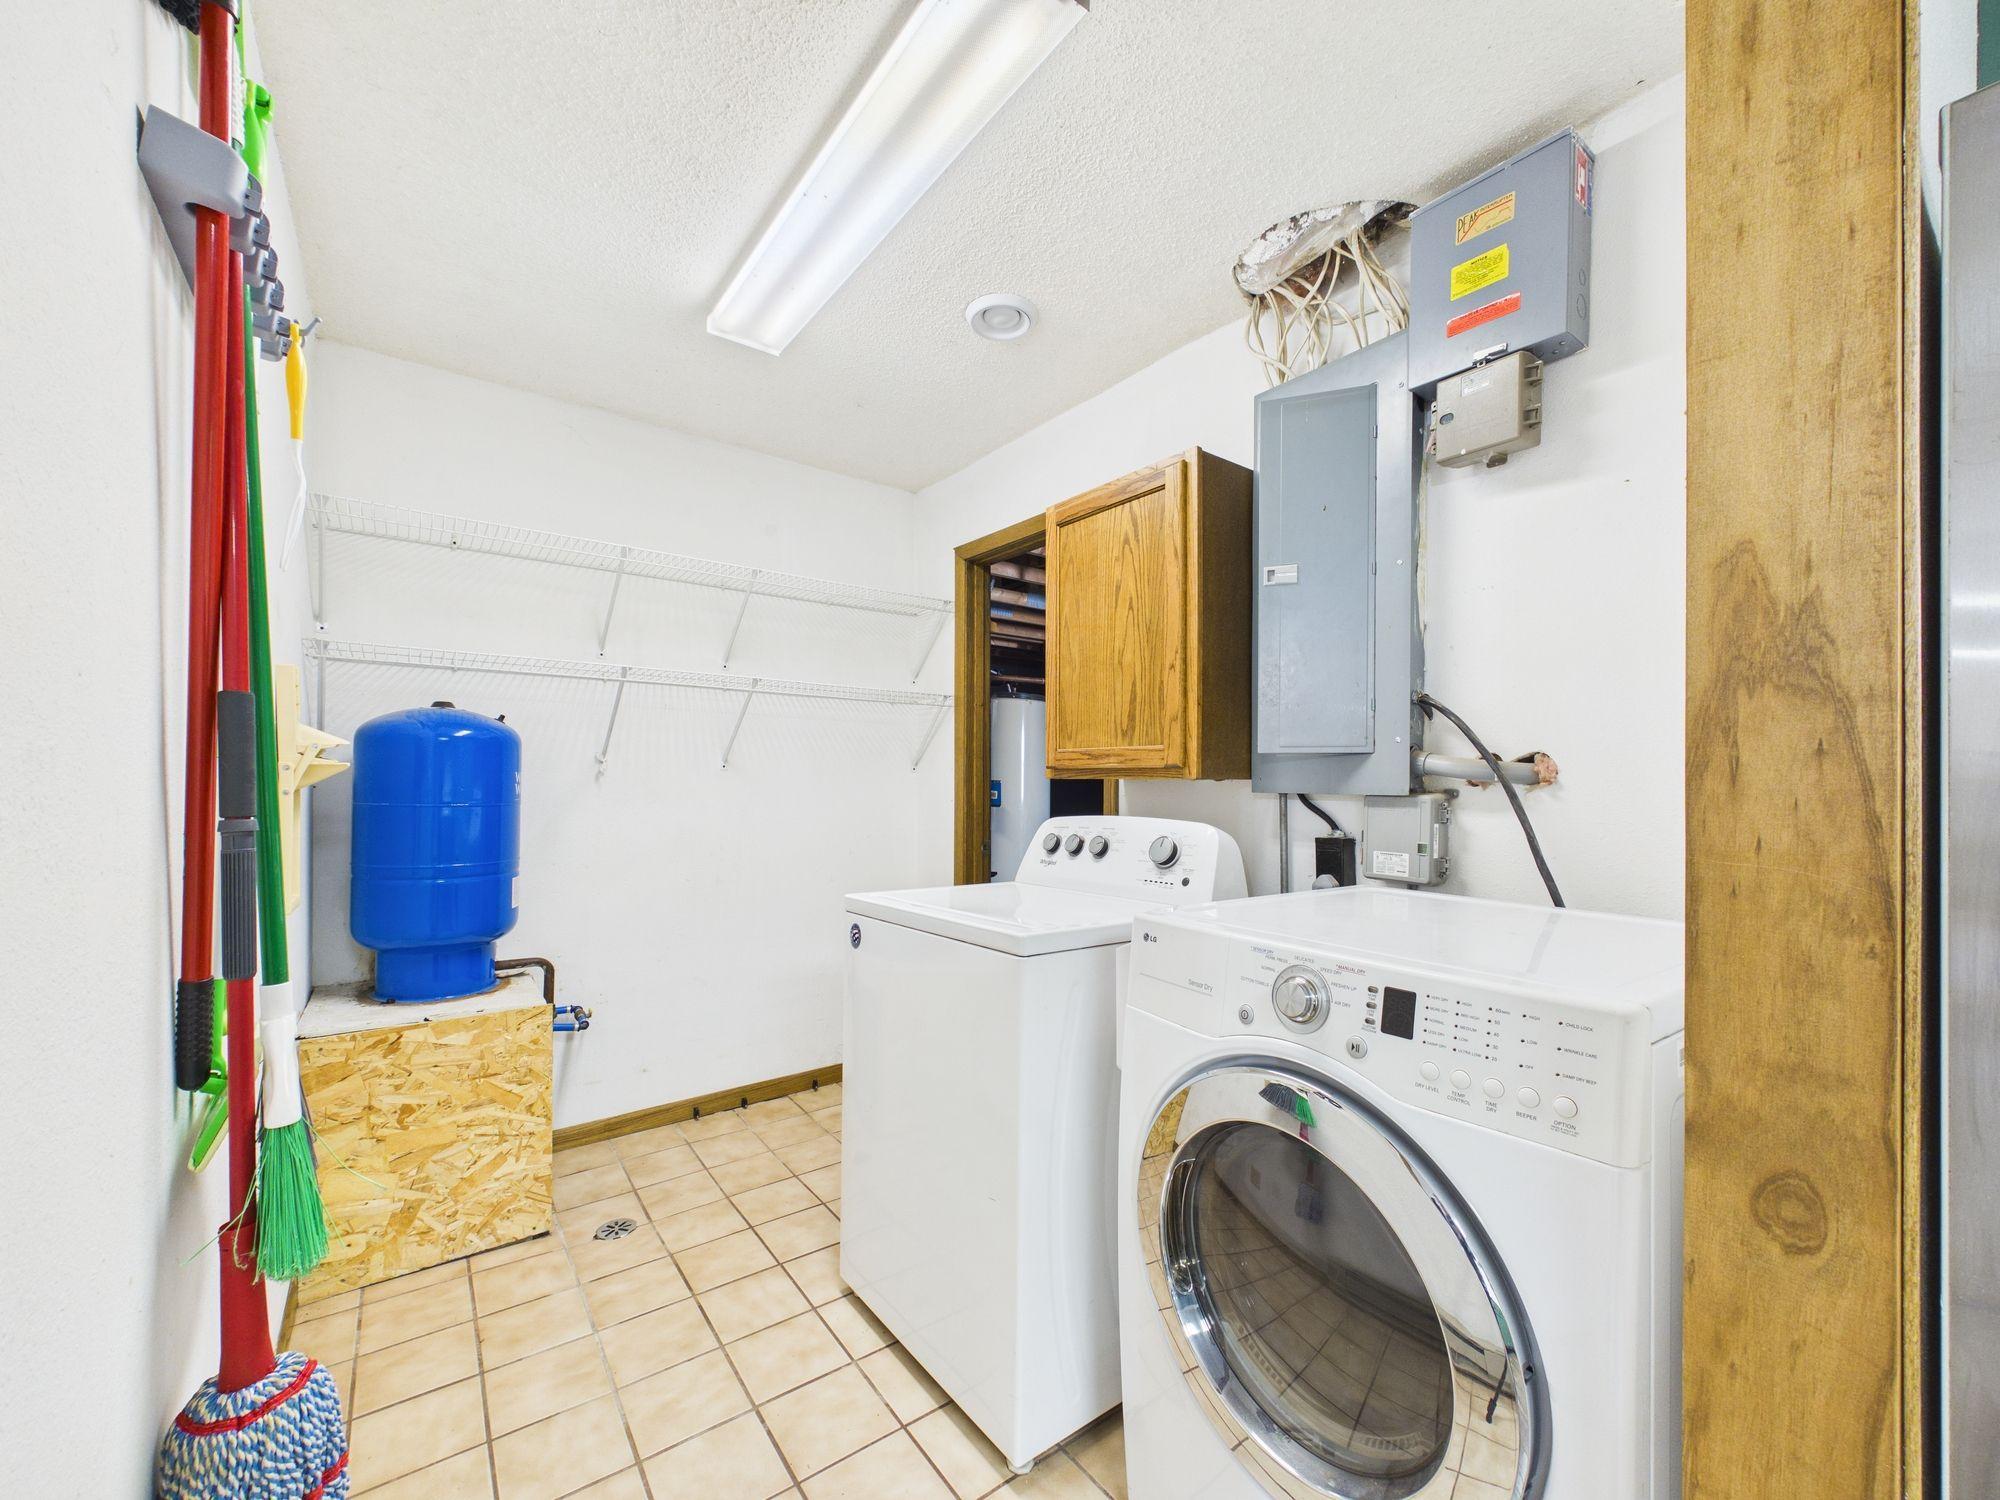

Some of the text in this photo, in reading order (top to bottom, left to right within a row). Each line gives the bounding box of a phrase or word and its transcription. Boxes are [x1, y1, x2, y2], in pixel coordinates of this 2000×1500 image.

[1425, 1084, 1440, 1094] LEVEL
[1451, 1090, 1466, 1098] TEMP
[1446, 1095, 1471, 1106] CONTROL
[1485, 1100, 1498, 1108] TIME
[1515, 1111, 1537, 1121] BEEPER
[1553, 1120, 1577, 1131] OPTION
